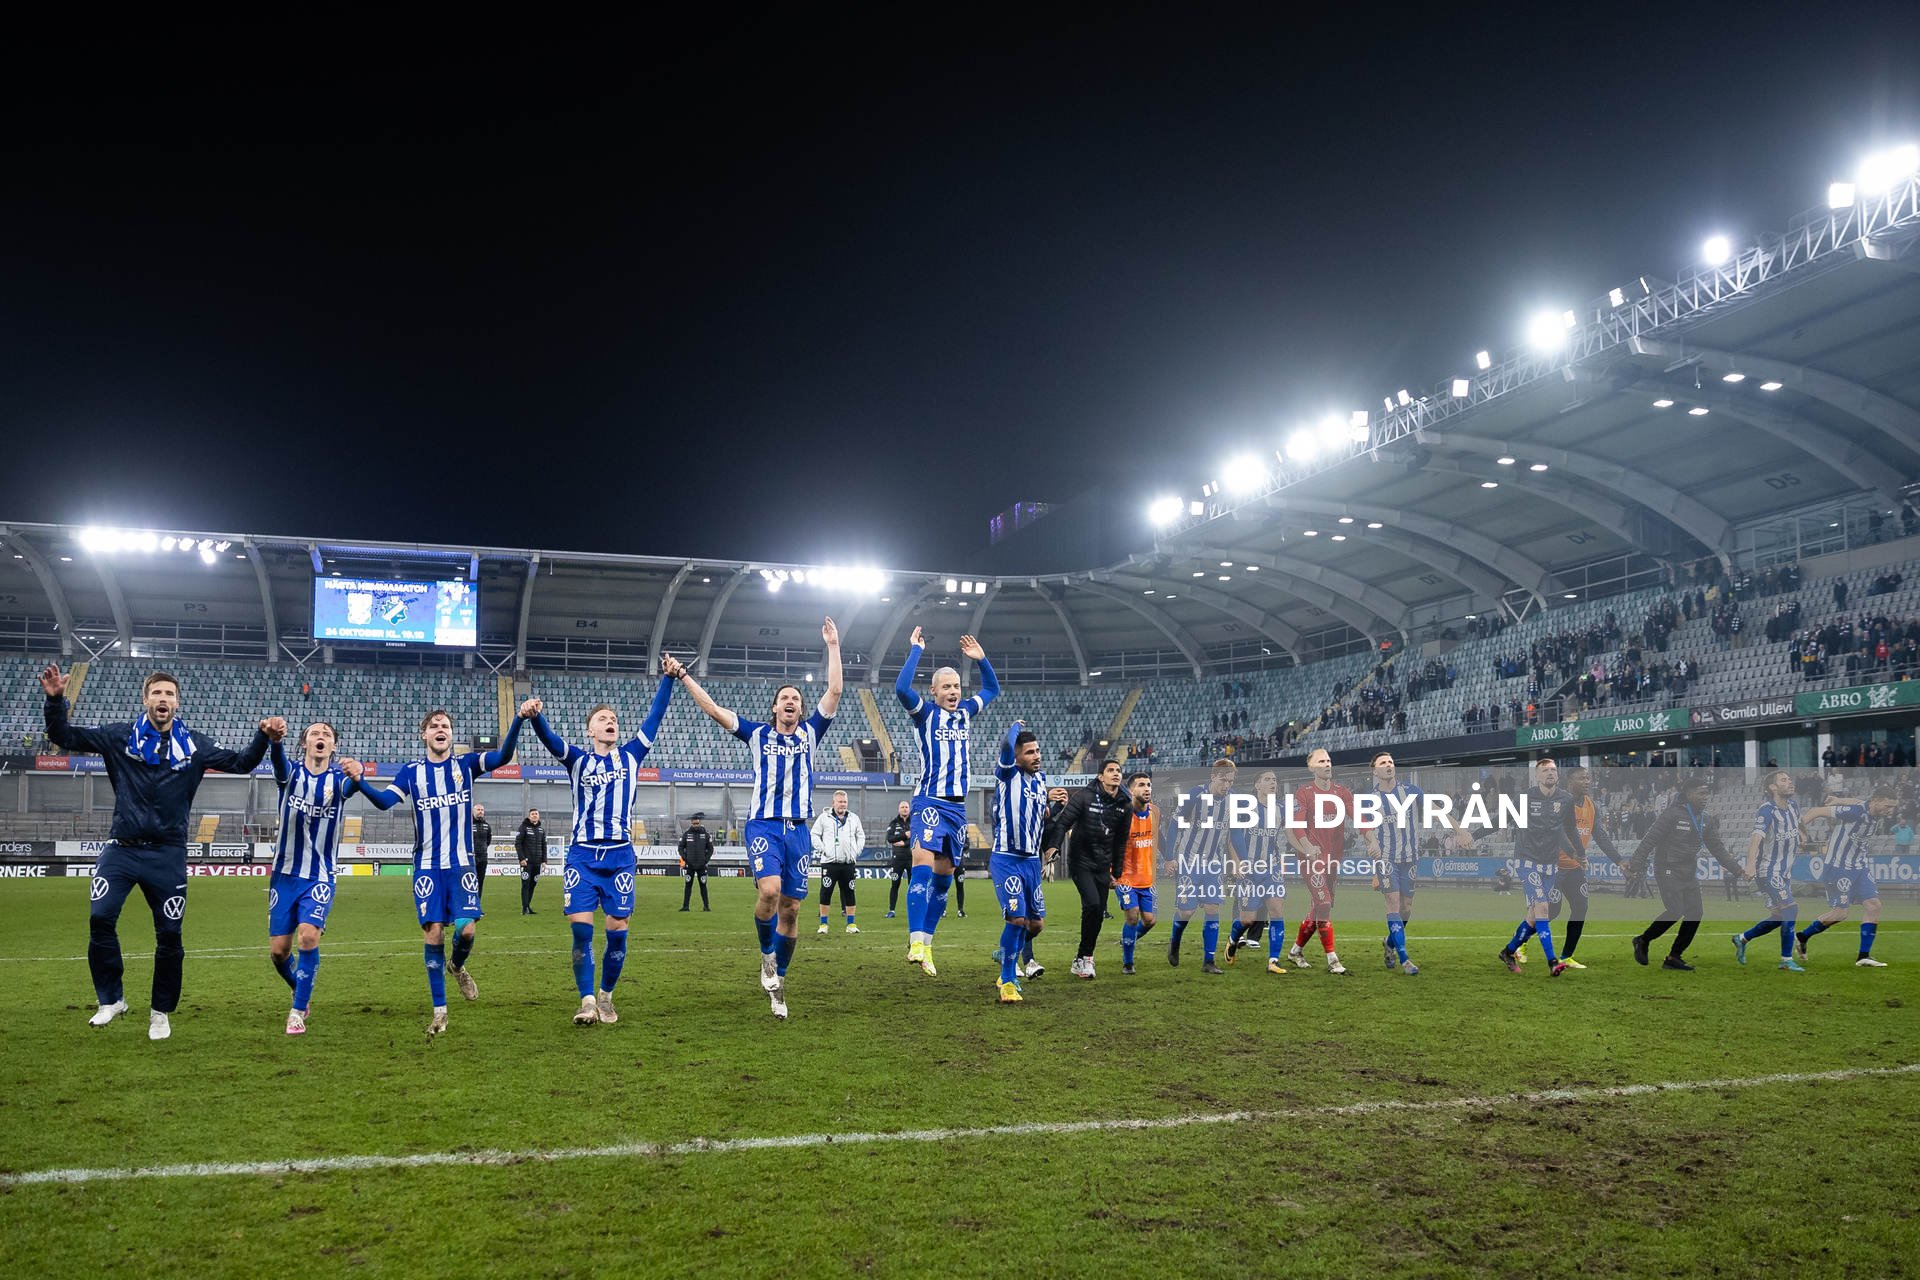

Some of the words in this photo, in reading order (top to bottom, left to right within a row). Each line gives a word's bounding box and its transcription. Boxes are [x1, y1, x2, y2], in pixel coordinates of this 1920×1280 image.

[1765, 473, 1800, 490] D5
[576, 619, 599, 629] B4
[1818, 692, 1862, 709] ÅBRO
[1720, 705, 1758, 720] Gamla
[1760, 700, 1793, 716] Ullevi
[1613, 717, 1644, 732] ÅBRO
[934, 729, 969, 741] SERNEK
[1531, 727, 1558, 741] ÅBRO
[694, 771, 715, 779] ÖPPET,
[416, 789, 471, 811] SERNEKE
[287, 794, 337, 819] SERNEKE
[0, 842, 32, 852] nders
[1445, 861, 1479, 871] GÖTEBORG
[467, 895, 476, 905] 14
[621, 896, 628, 904] 17
[313, 905, 324, 916] 21
